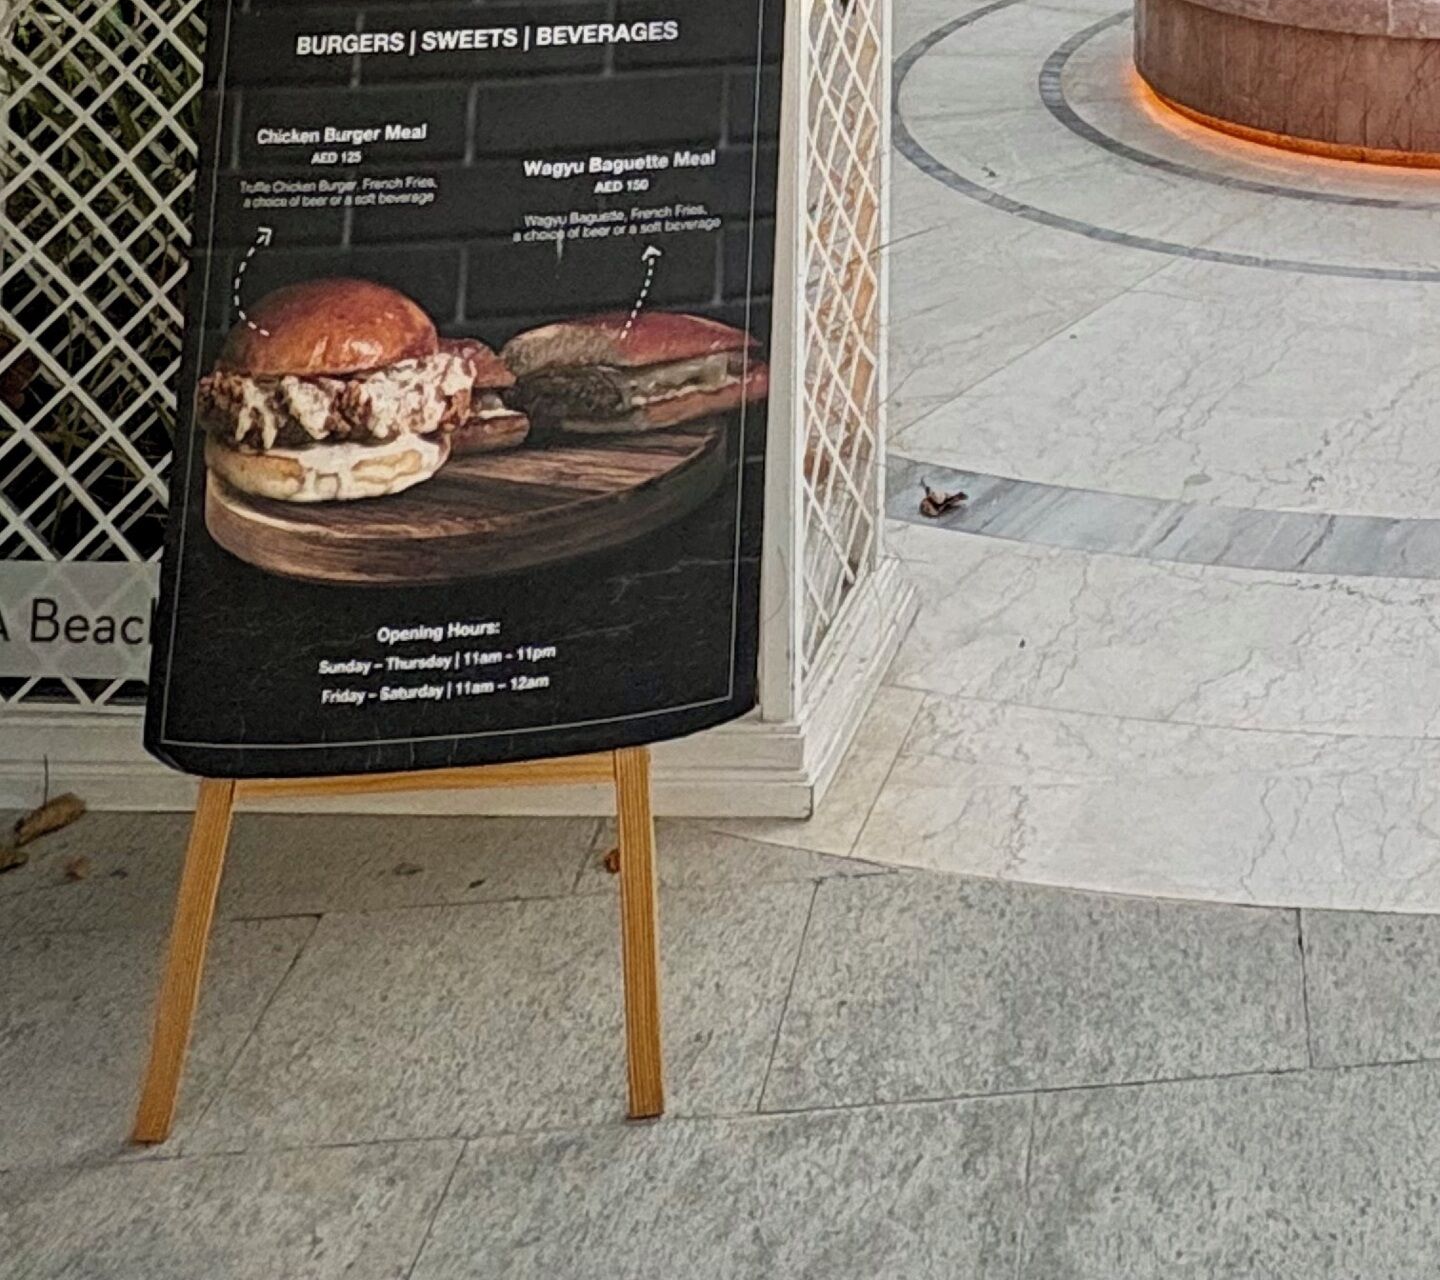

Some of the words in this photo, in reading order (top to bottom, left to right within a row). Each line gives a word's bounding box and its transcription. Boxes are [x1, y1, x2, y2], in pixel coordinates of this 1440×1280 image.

[296, 31, 404, 55] BURGERS
[420, 27, 518, 52] SWEETS
[535, 20, 679, 46] BEVERAGES
[257, 127, 320, 144] Chicken
[324, 126, 381, 145] Burger
[384, 123, 428, 141] Meal
[310, 151, 338, 165] AED
[341, 150, 362, 164] 125
[523, 159, 585, 178] Wagyu
[588, 154, 669, 174] Baguette
[672, 148, 716, 168] Meal
[362, 177, 403, 190] French
[594, 179, 623, 193] AED
[524, 214, 567, 229] Wagyu
[630, 205, 672, 220] French
[567, 225, 581, 239] of
[665, 217, 721, 231] beverage
[376, 624, 443, 645] Opening
[447, 621, 501, 639] Hours:
[318, 659, 372, 676] Sunday
[385, 653, 453, 671] Thursday
[463, 649, 502, 666] 11am
[516, 645, 556, 663] 11pm
[321, 689, 367, 706] Friday
[379, 684, 444, 702] Saturday
[455, 680, 495, 696] 11am
[510, 675, 550, 691] 12am
